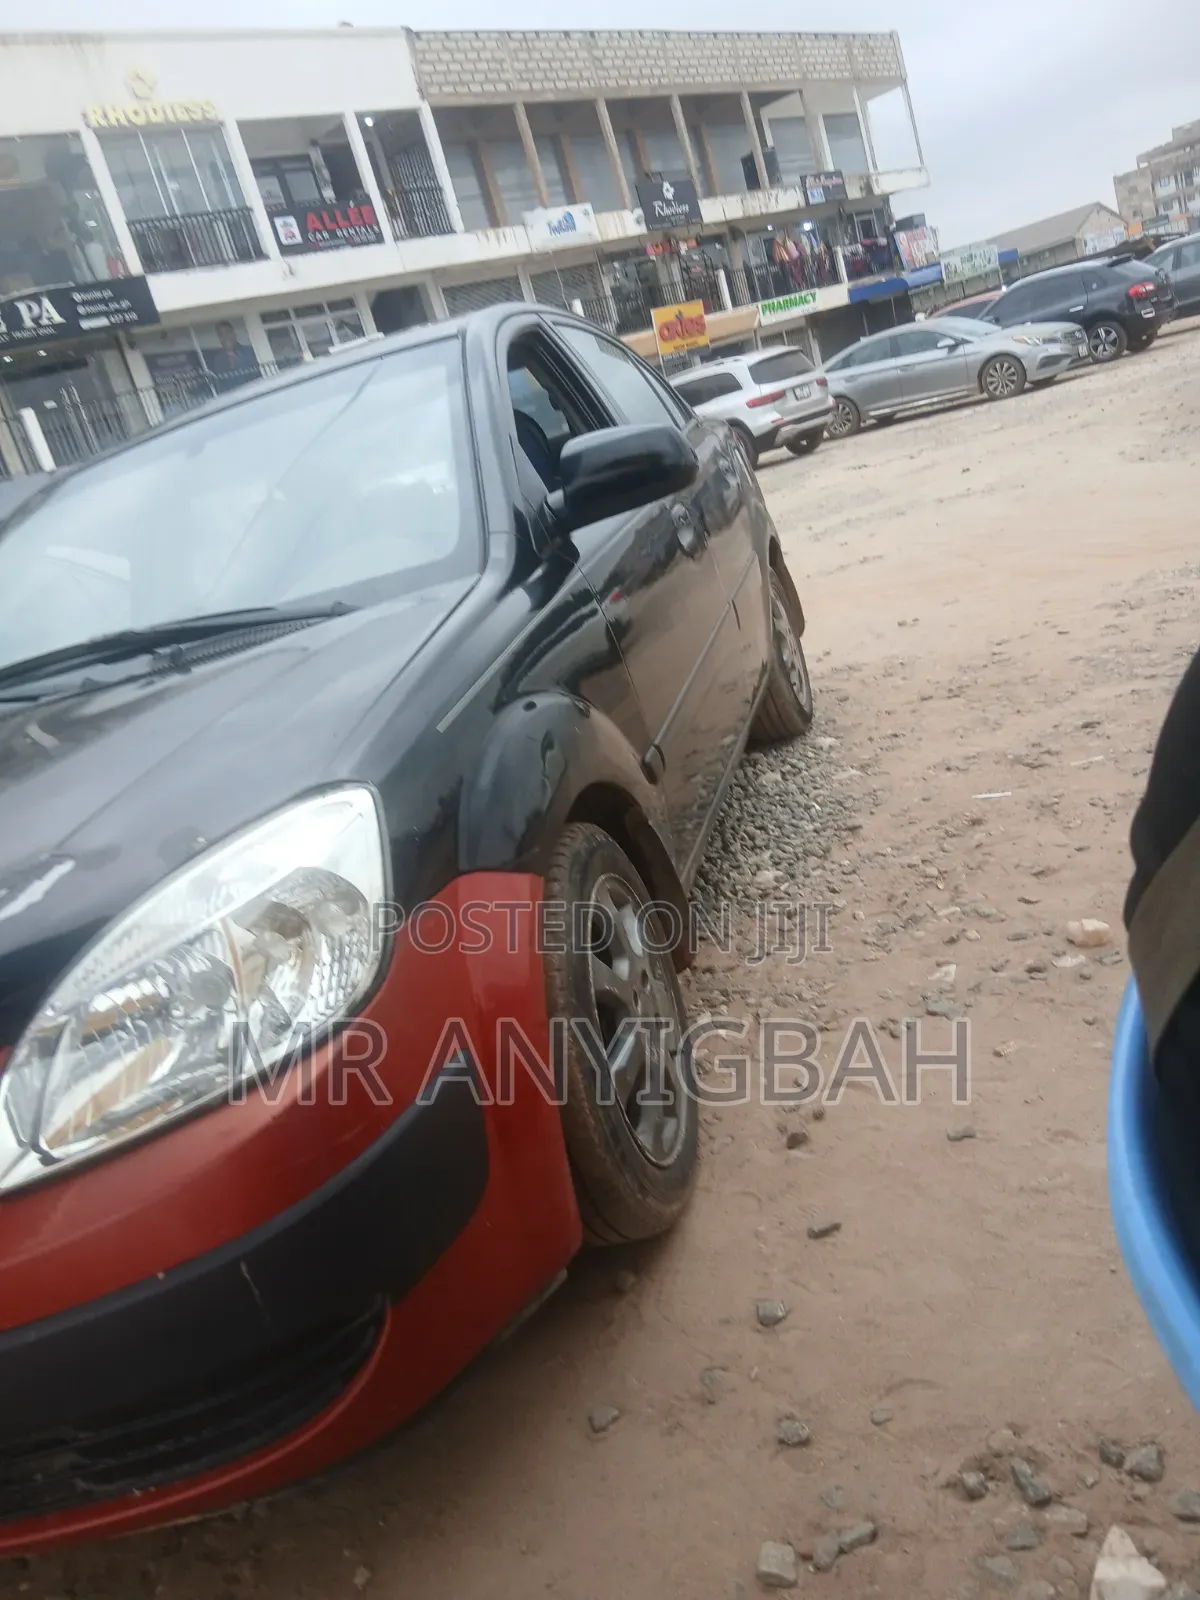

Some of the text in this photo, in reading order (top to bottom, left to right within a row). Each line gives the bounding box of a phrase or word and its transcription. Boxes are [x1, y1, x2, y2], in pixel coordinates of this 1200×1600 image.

[308, 231, 330, 242] CAR
[336, 224, 380, 239] RENTALS
[14, 293, 67, 329] PA
[761, 292, 817, 316] PHARMACY
